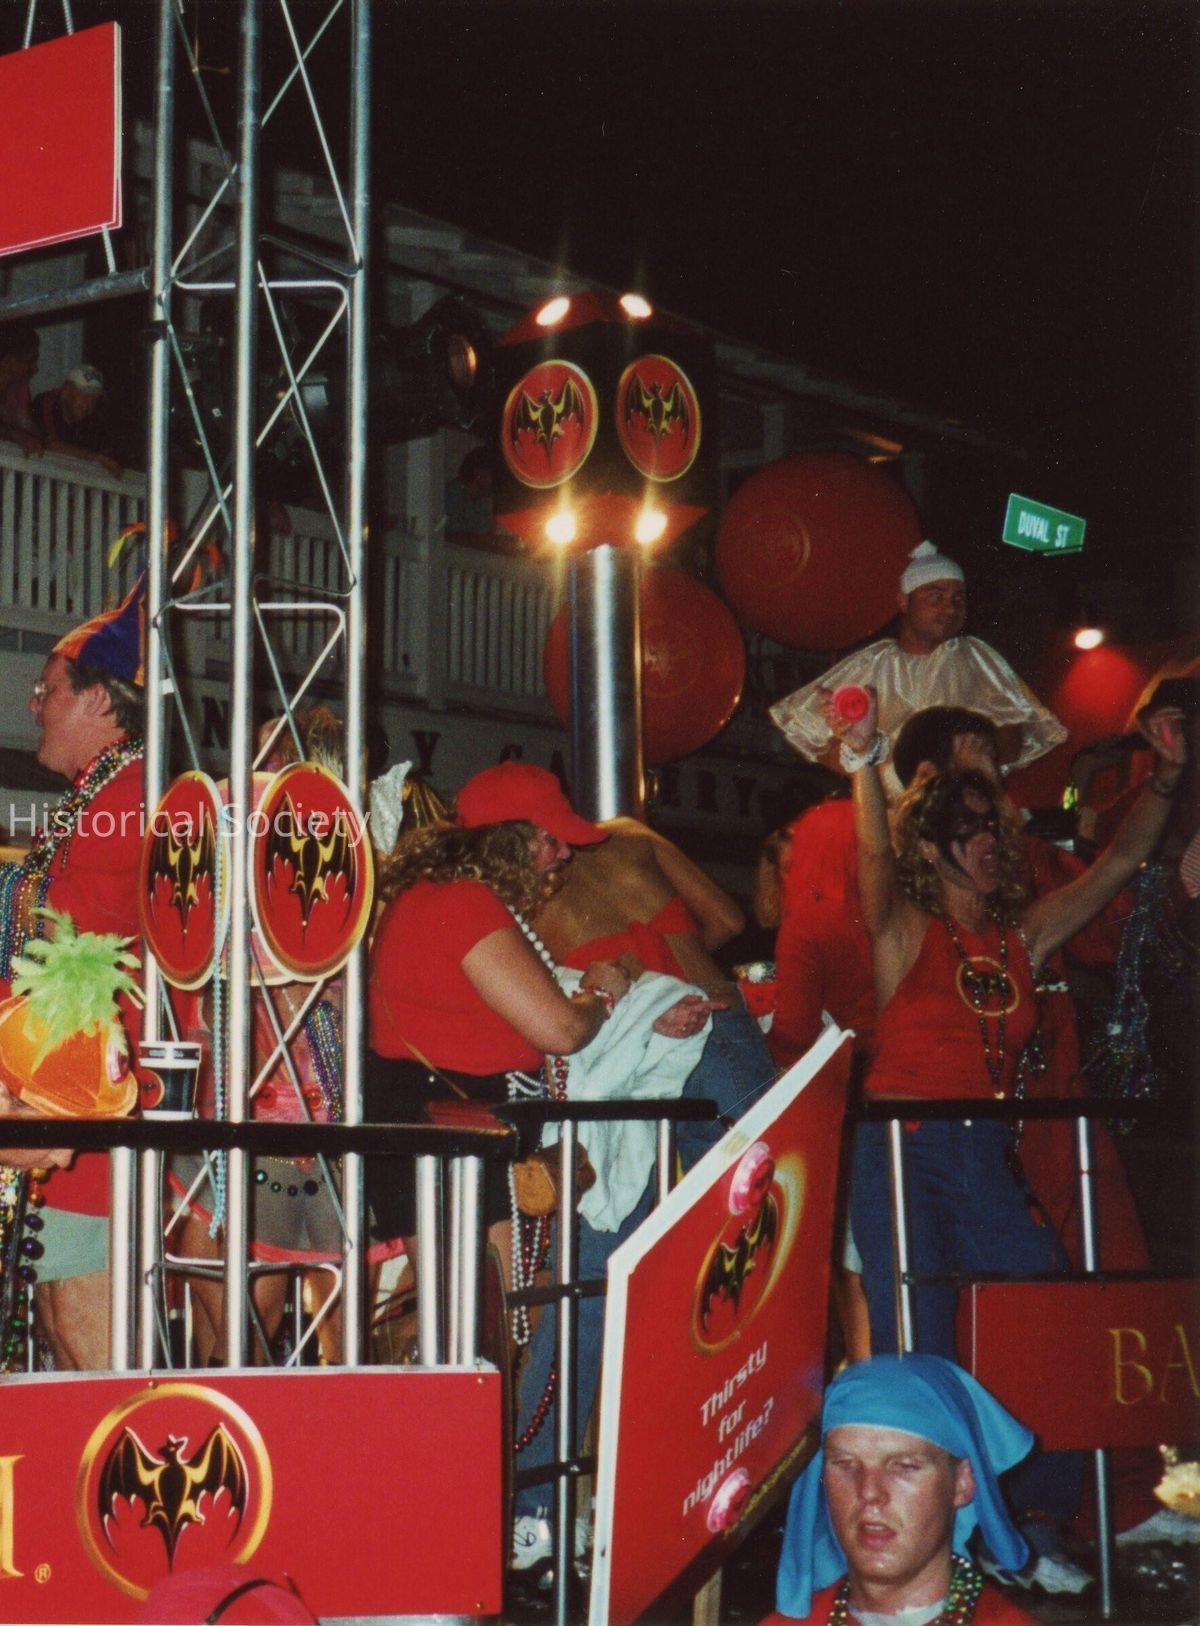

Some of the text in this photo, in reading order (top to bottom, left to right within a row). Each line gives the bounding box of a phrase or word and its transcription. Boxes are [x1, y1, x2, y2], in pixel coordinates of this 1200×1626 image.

[1018, 511, 1070, 548] DUVAL ST
[699, 1340, 769, 1427] Thirsty
[717, 1399, 747, 1443] for
[682, 1396, 775, 1517] nightlife?
